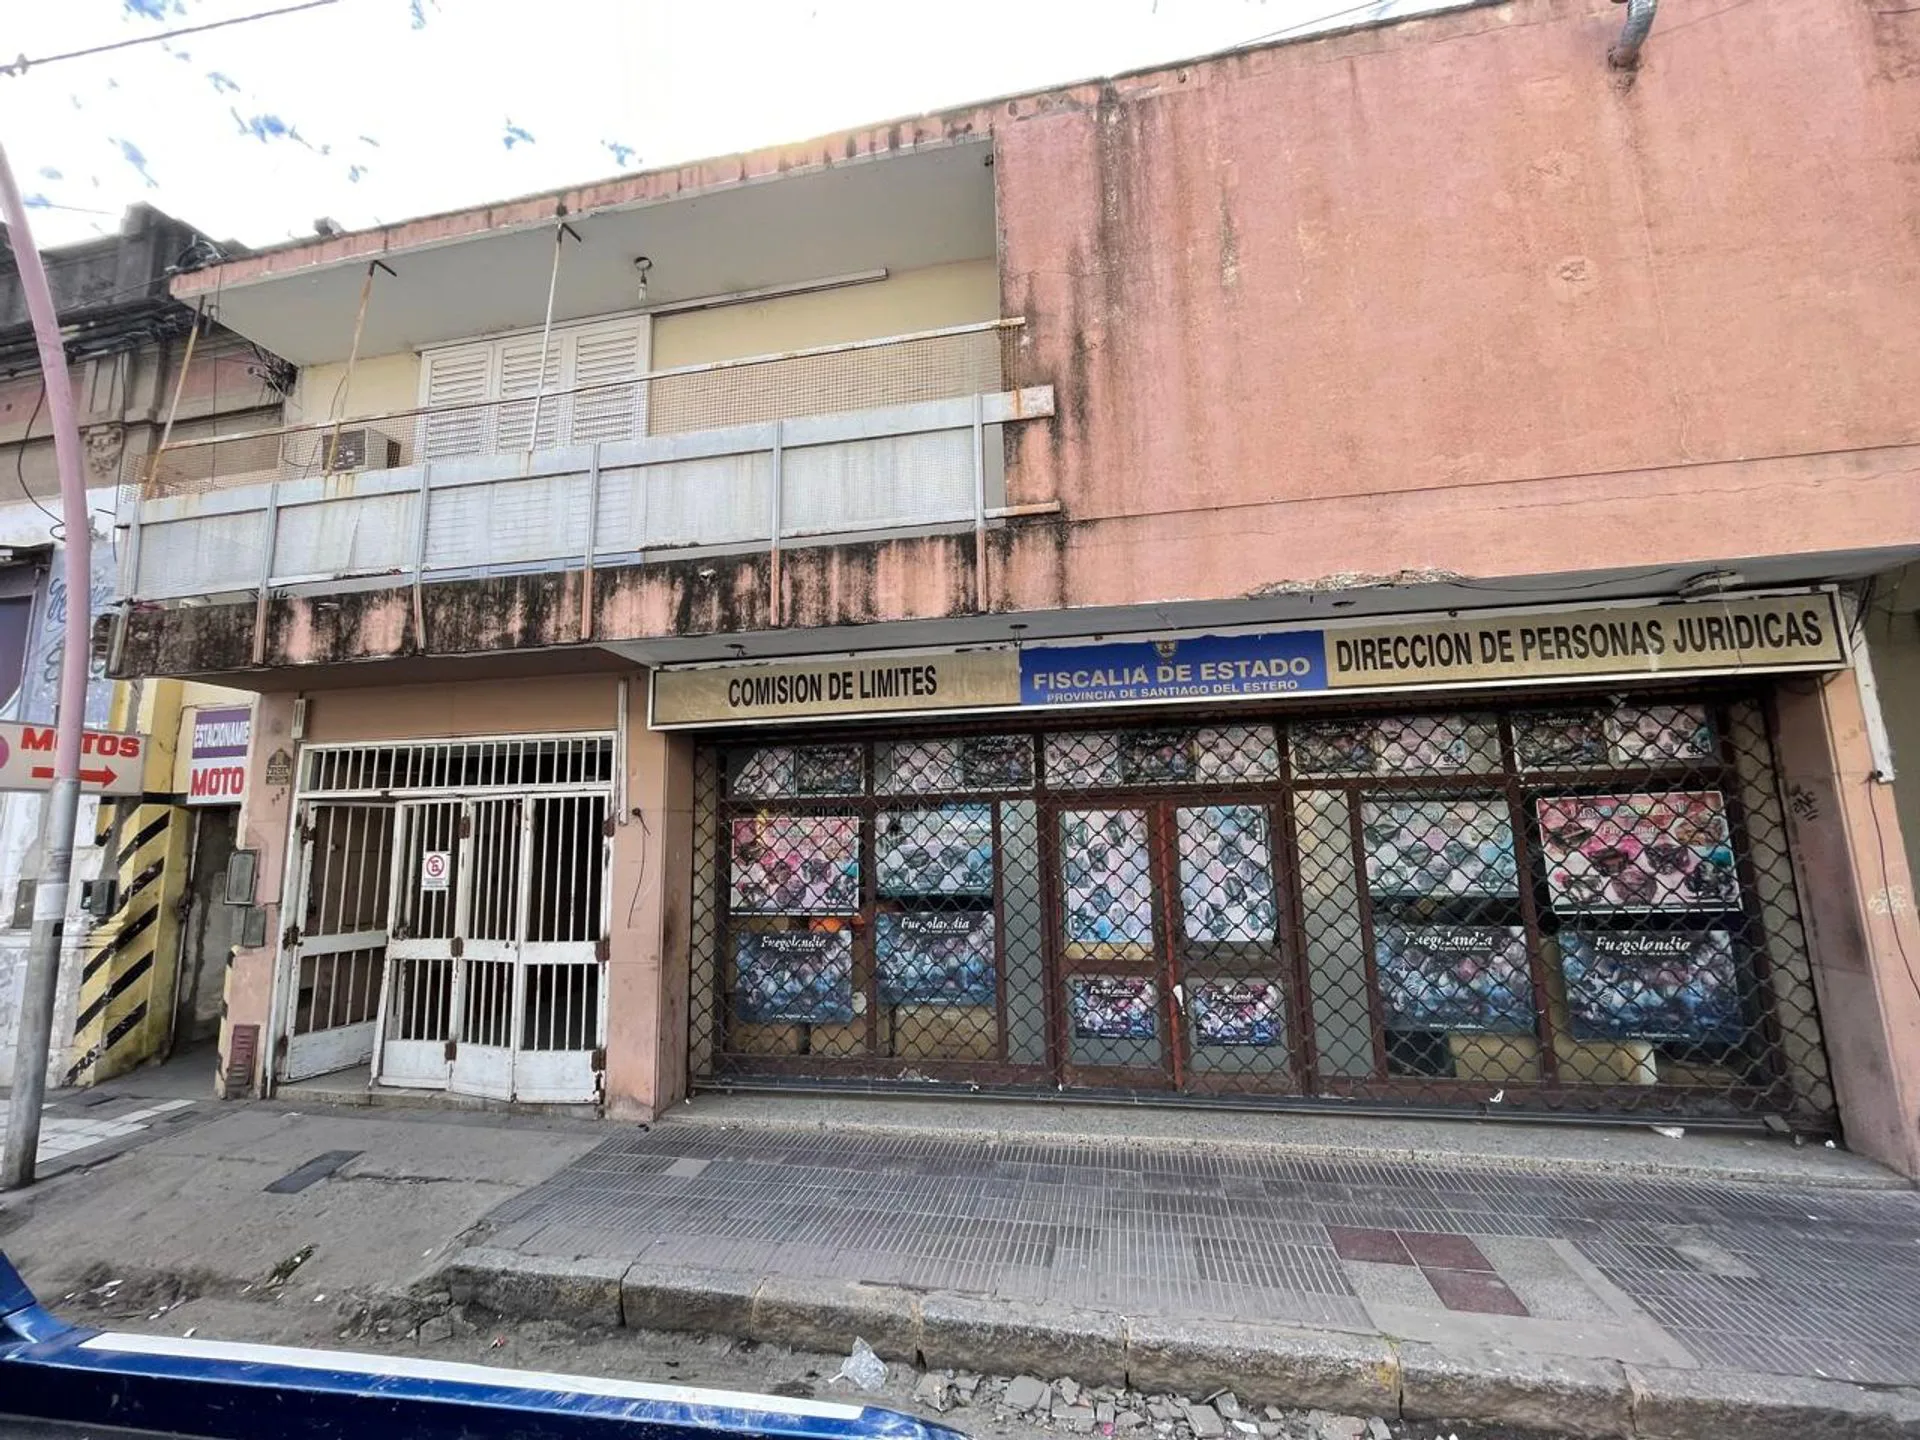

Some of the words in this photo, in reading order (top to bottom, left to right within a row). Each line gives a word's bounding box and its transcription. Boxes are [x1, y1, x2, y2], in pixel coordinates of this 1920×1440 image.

[1336, 632, 1472, 671] DIRECCION
[1479, 630, 1515, 664] DE
[1519, 620, 1665, 662] PERSONAS
[1673, 610, 1823, 653] JURIDICAS
[728, 673, 822, 707] COMISION
[828, 671, 853, 700] DE
[860, 665, 938, 699] LIMITES
[1034, 665, 1149, 690] FISCALIA
[1157, 664, 1192, 683] DE
[1200, 657, 1311, 681] ESTADO
[1047, 690, 1116, 703] PROVINCIA
[1120, 688, 1137, 699] DE
[1141, 684, 1209, 698] SANTIAGO
[1213, 683, 1240, 694] DEL
[1243, 680, 1299, 693] ESTERO
[21, 727, 140, 758] MTOS
[191, 766, 245, 796] MOTO
